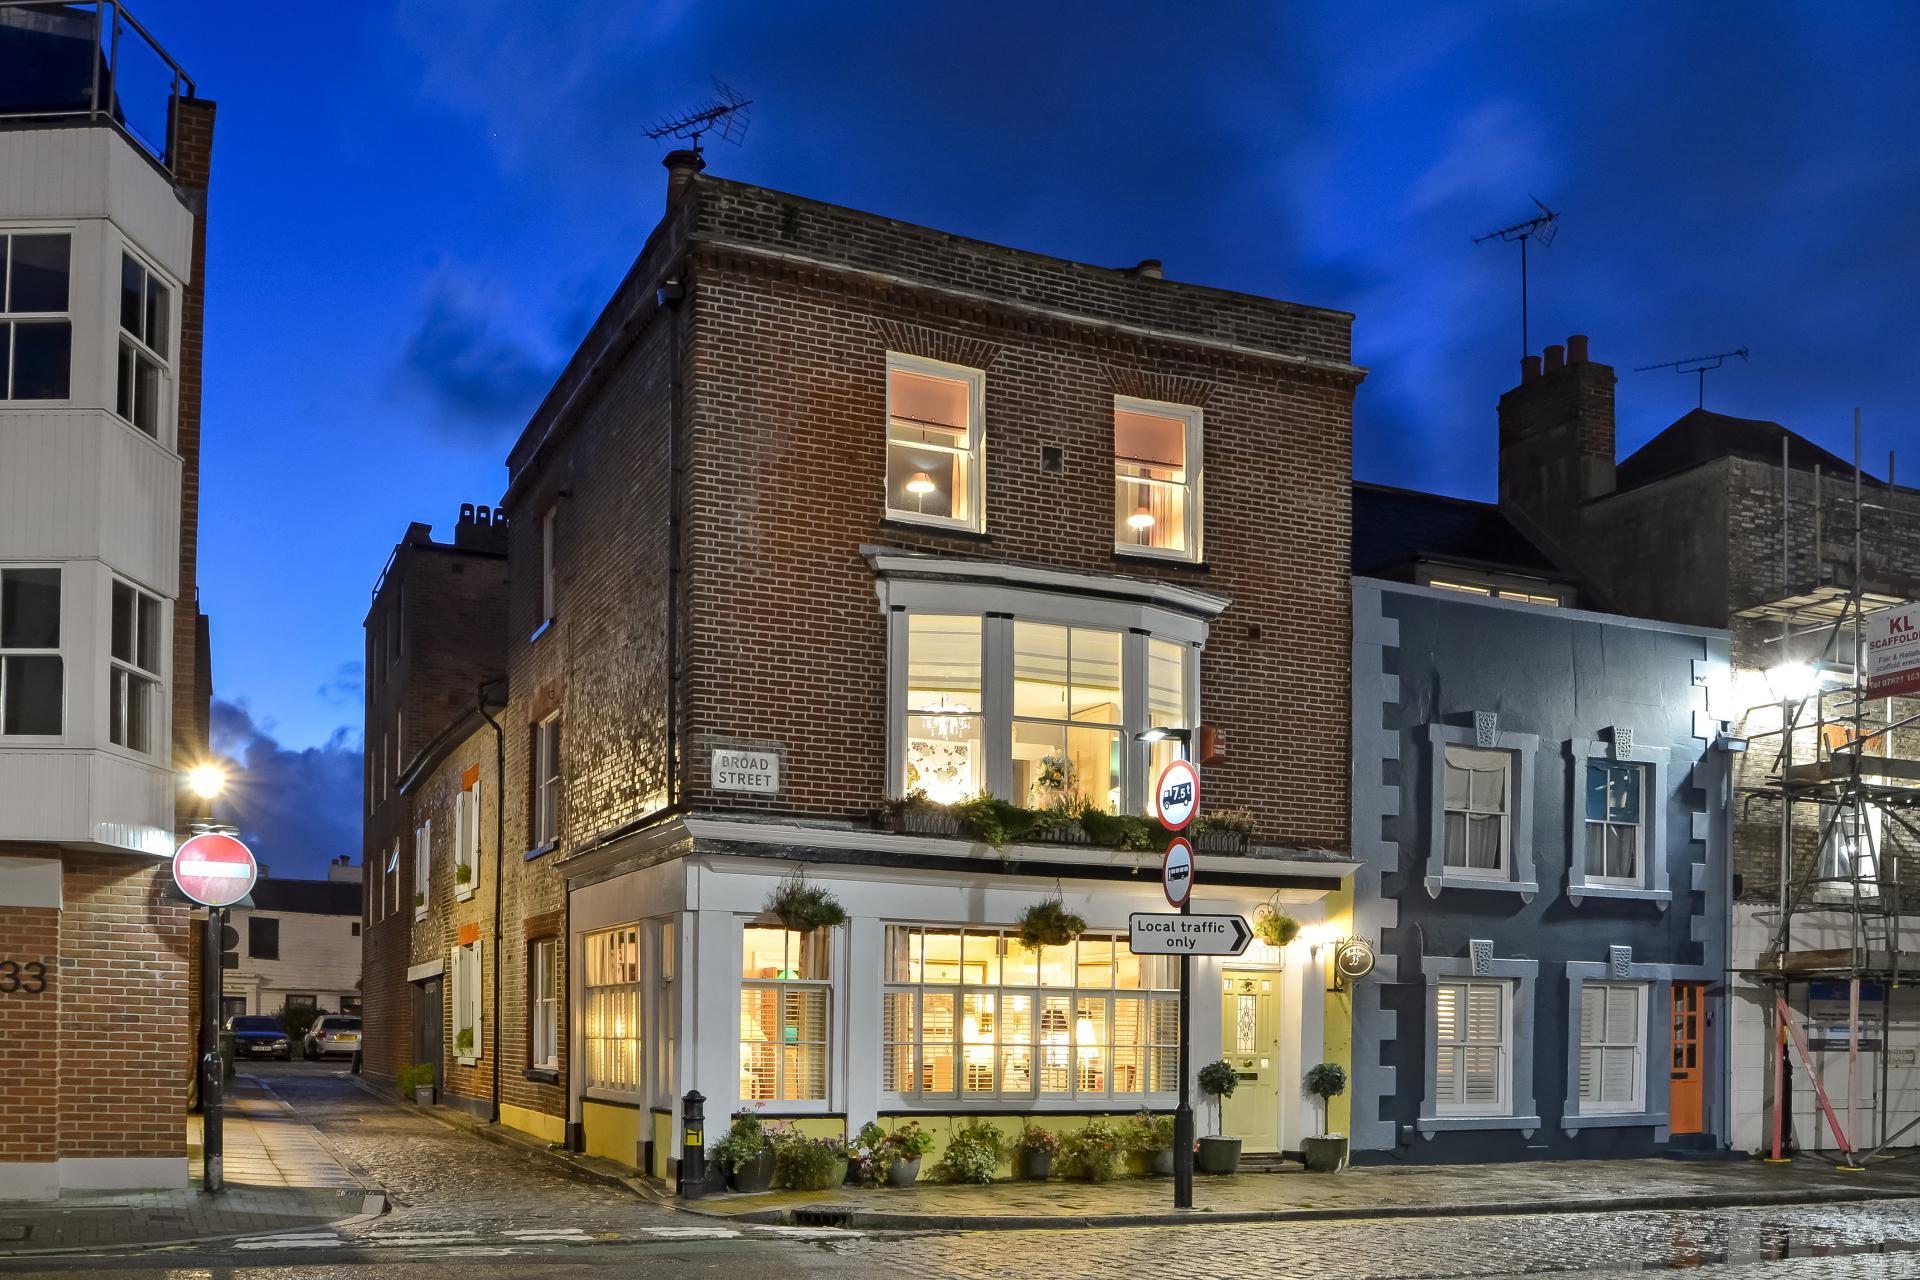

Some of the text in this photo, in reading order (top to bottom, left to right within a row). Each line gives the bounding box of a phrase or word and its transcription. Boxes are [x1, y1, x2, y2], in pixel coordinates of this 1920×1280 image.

[1889, 615, 1915, 635] KL
[722, 756, 769, 770] BROAD
[719, 772, 772, 787] STREET
[1137, 919, 1226, 934] Local traffic
[1166, 936, 1197, 950] only
[0, 960, 47, 994] 33
